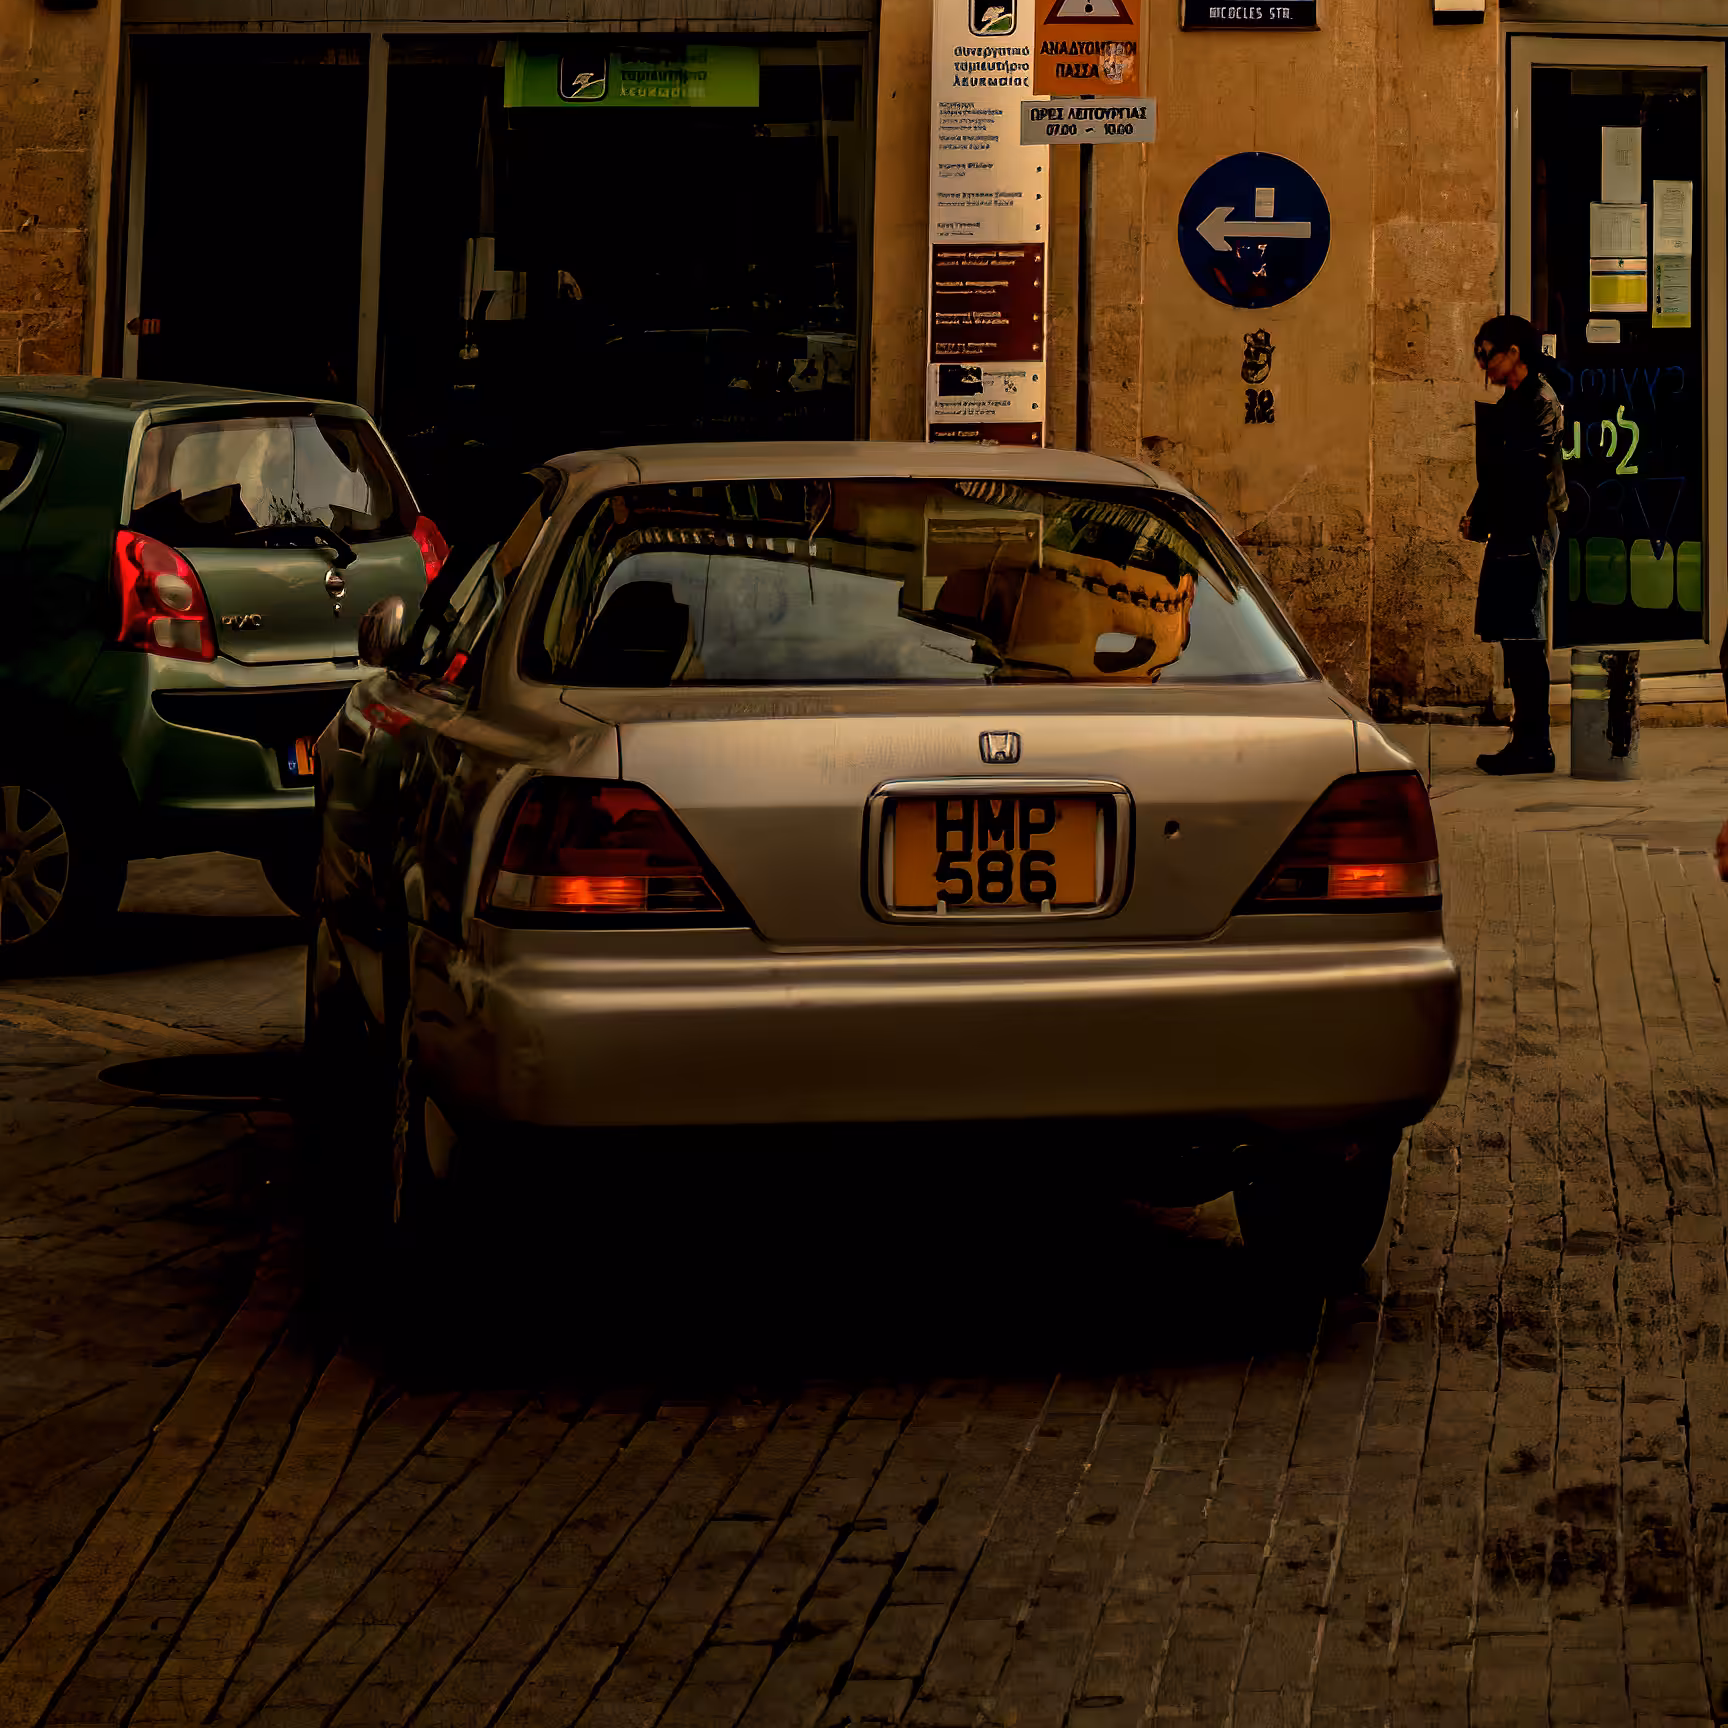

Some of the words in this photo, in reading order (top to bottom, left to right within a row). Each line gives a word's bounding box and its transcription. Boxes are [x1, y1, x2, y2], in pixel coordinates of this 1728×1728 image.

[1209, 7, 1263, 19] NICOCLES
[1030, 107, 1063, 121] ΩΡΕΣ
[936, 799, 1056, 852] HMP
[936, 849, 1057, 903] 586
